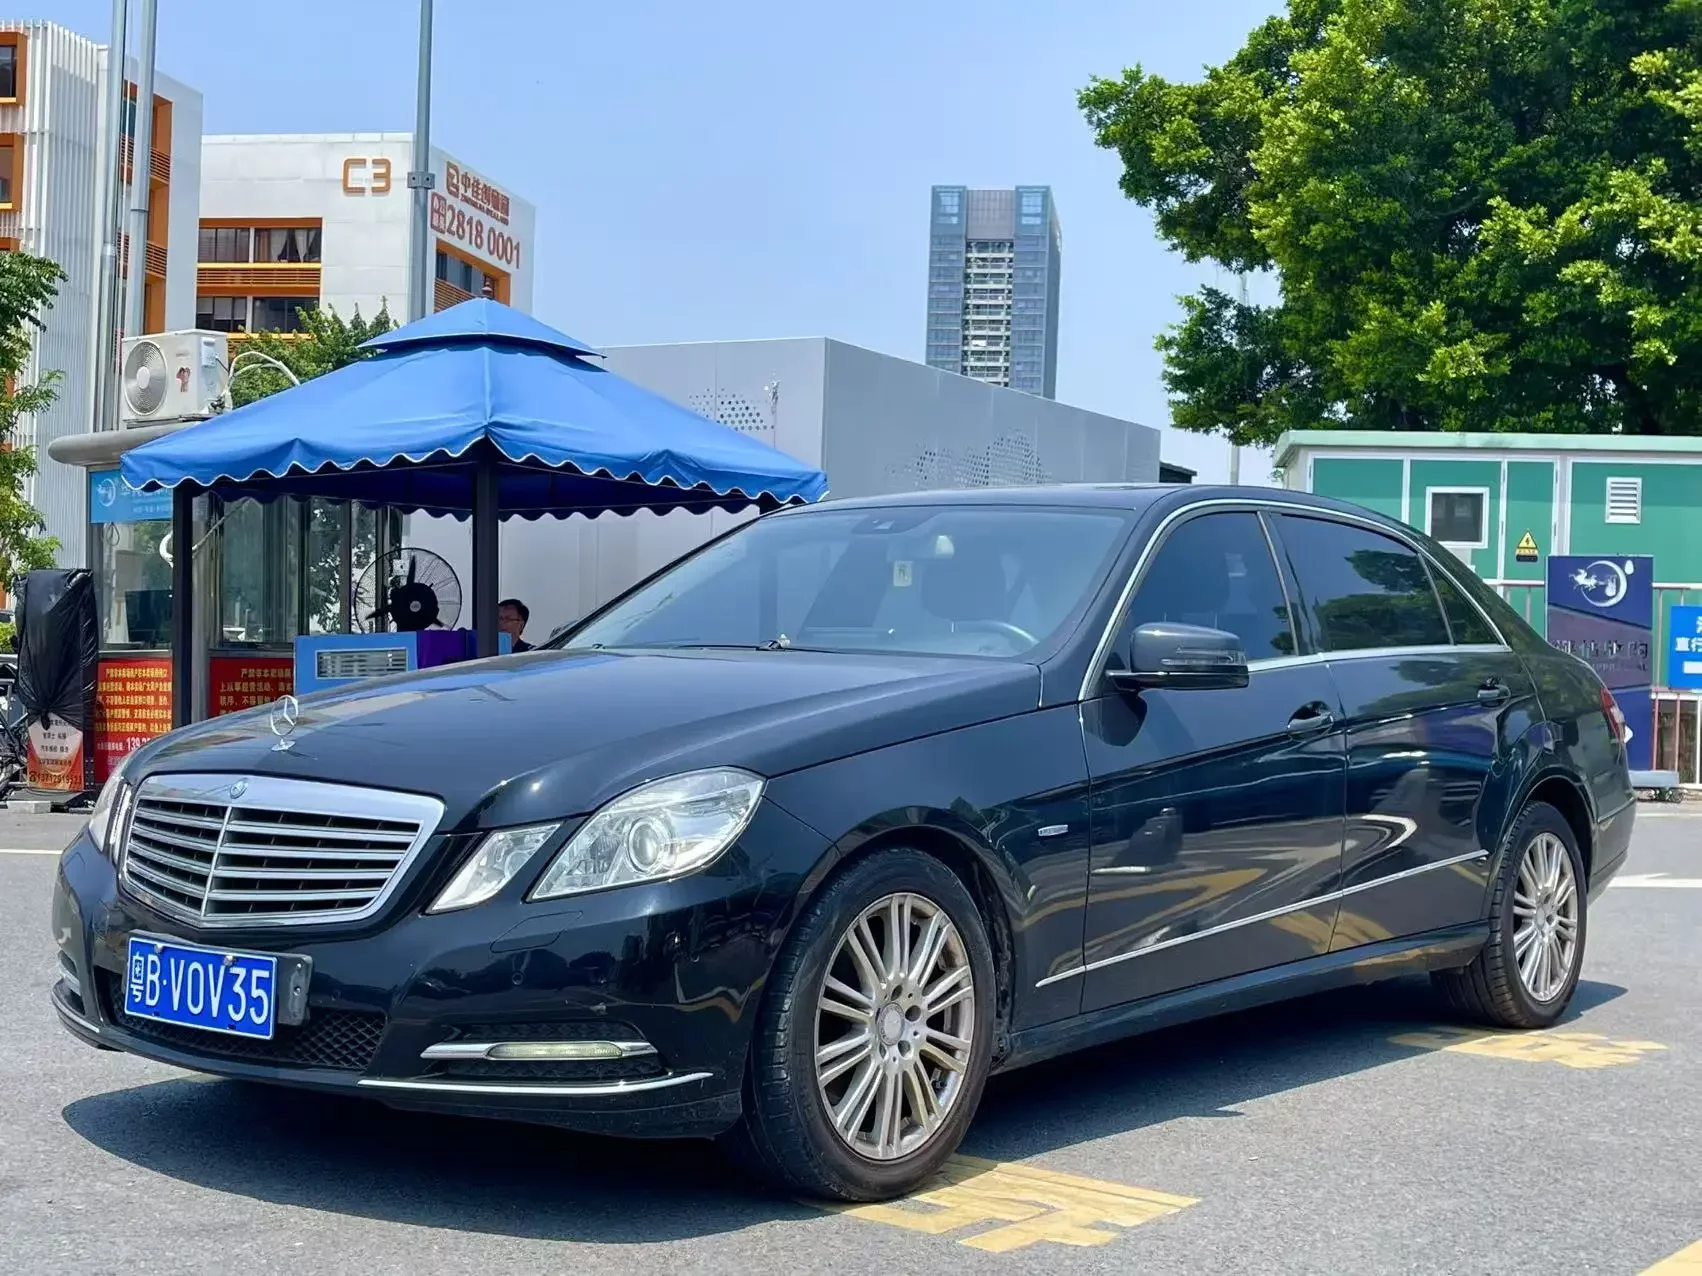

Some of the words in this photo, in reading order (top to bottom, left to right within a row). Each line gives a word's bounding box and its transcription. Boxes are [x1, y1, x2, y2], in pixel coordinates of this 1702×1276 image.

[342, 158, 391, 193] C3
[446, 203, 484, 250] 2818
[487, 226, 521, 270] 0001
